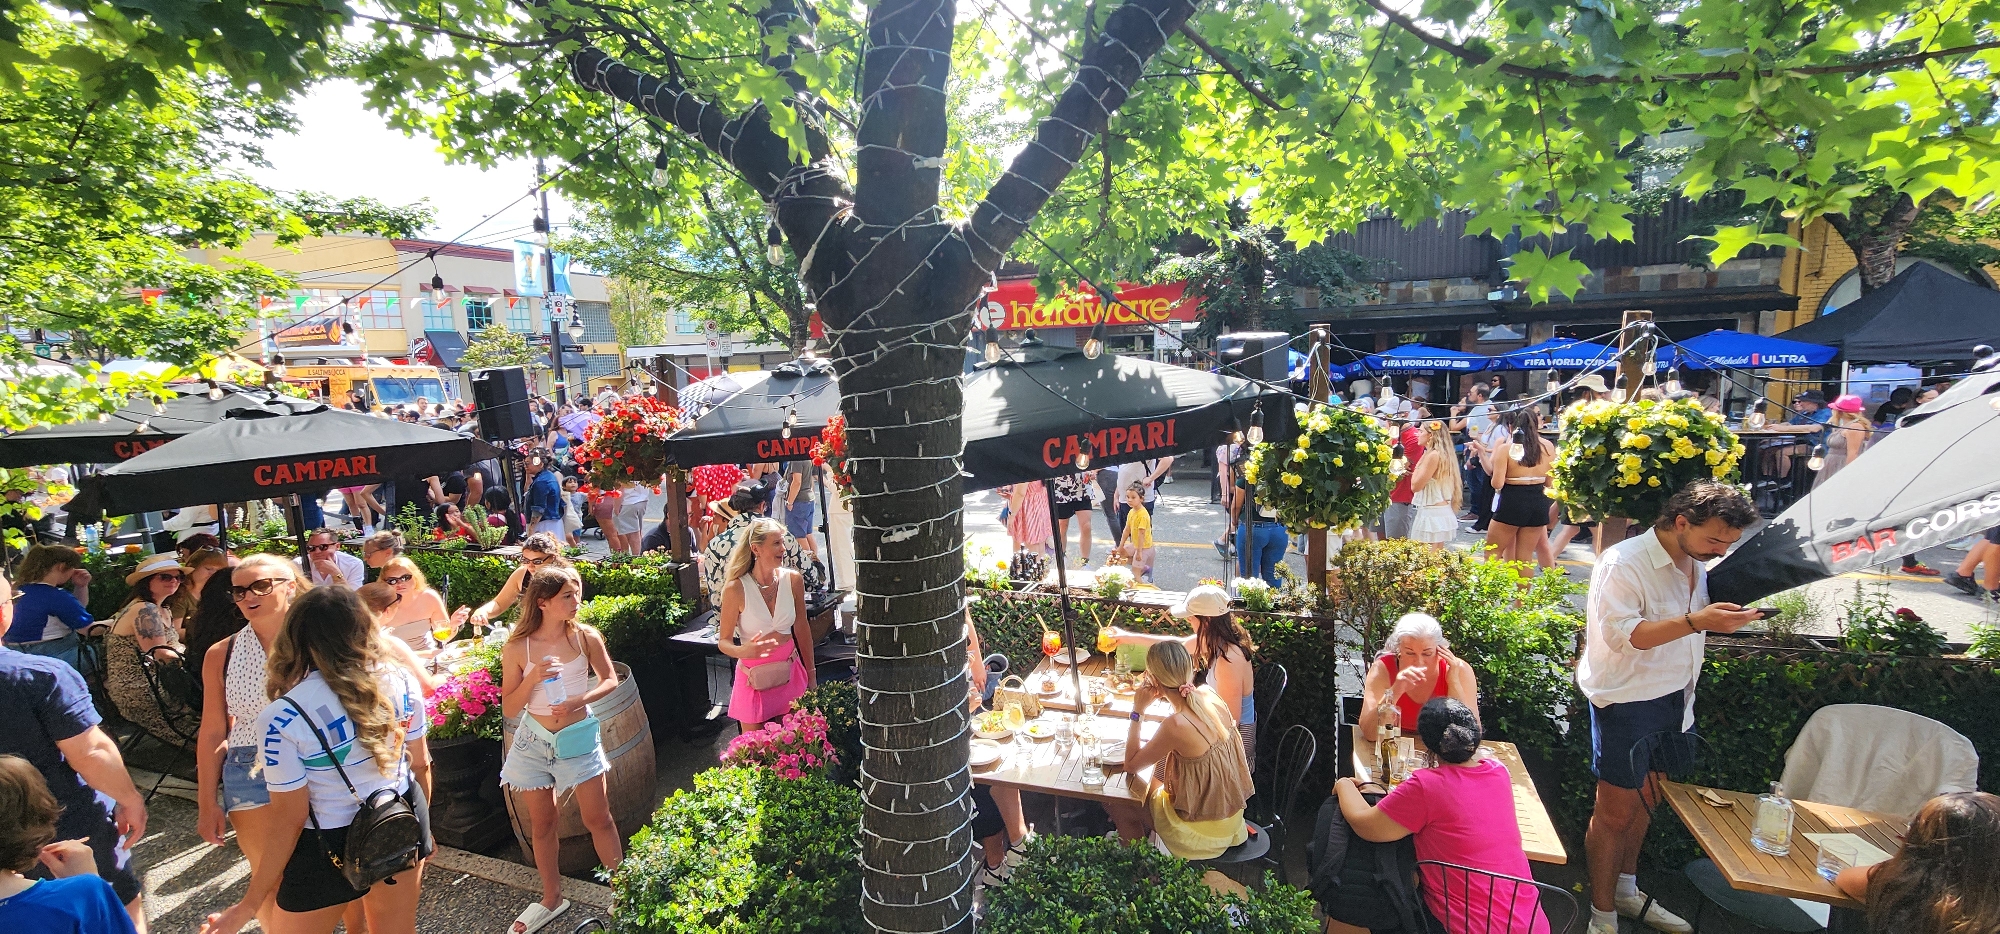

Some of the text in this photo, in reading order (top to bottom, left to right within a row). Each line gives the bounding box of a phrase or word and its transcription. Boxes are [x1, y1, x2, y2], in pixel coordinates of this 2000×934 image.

[1010, 295, 1171, 328] hardware
[1382, 360, 1401, 368] FIFA
[1402, 359, 1433, 367] WORLD
[1434, 359, 1451, 367] CUP
[1524, 359, 1546, 367] FIFA
[1547, 358, 1583, 367] WORLD
[1584, 358, 1606, 367] CUP
[1761, 354, 1808, 364] ULTRA
[113, 438, 165, 459] CAM
[757, 435, 821, 459] CAMPA
[1042, 418, 1176, 469] CAMPARI
[253, 454, 378, 486] CAMPARI
[1831, 491, 2000, 563] BAR CORS
[264, 707, 299, 767] ITALIA
